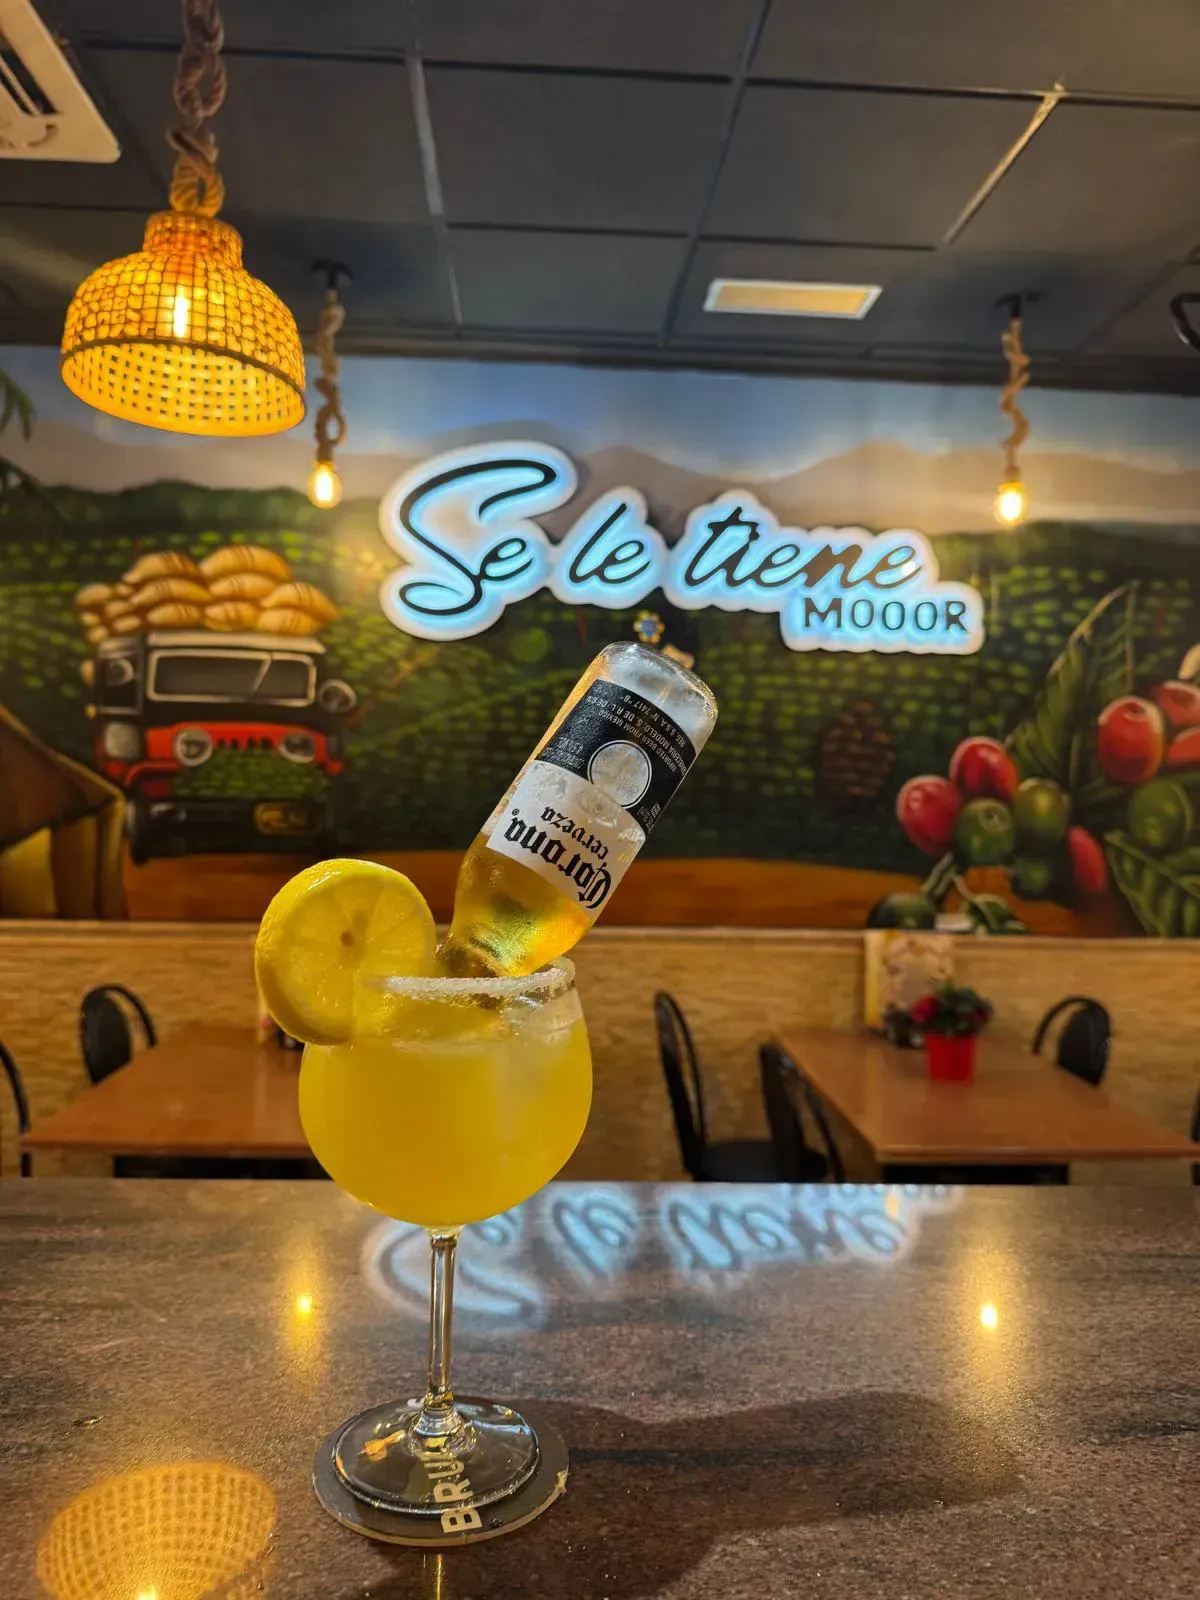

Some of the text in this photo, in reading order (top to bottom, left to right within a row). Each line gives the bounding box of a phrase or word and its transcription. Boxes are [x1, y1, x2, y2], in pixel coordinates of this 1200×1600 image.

[399, 459, 923, 616] Se le tiene
[803, 597, 968, 632] MOOOR
[623, 709, 635, 722] DE
[633, 699, 651, 716] 7417
[622, 721, 642, 739] FROM
[634, 716, 643, 727] S.
[640, 734, 658, 751] BEER
[540, 806, 609, 860] cerveza
[504, 817, 611, 909] Corona
